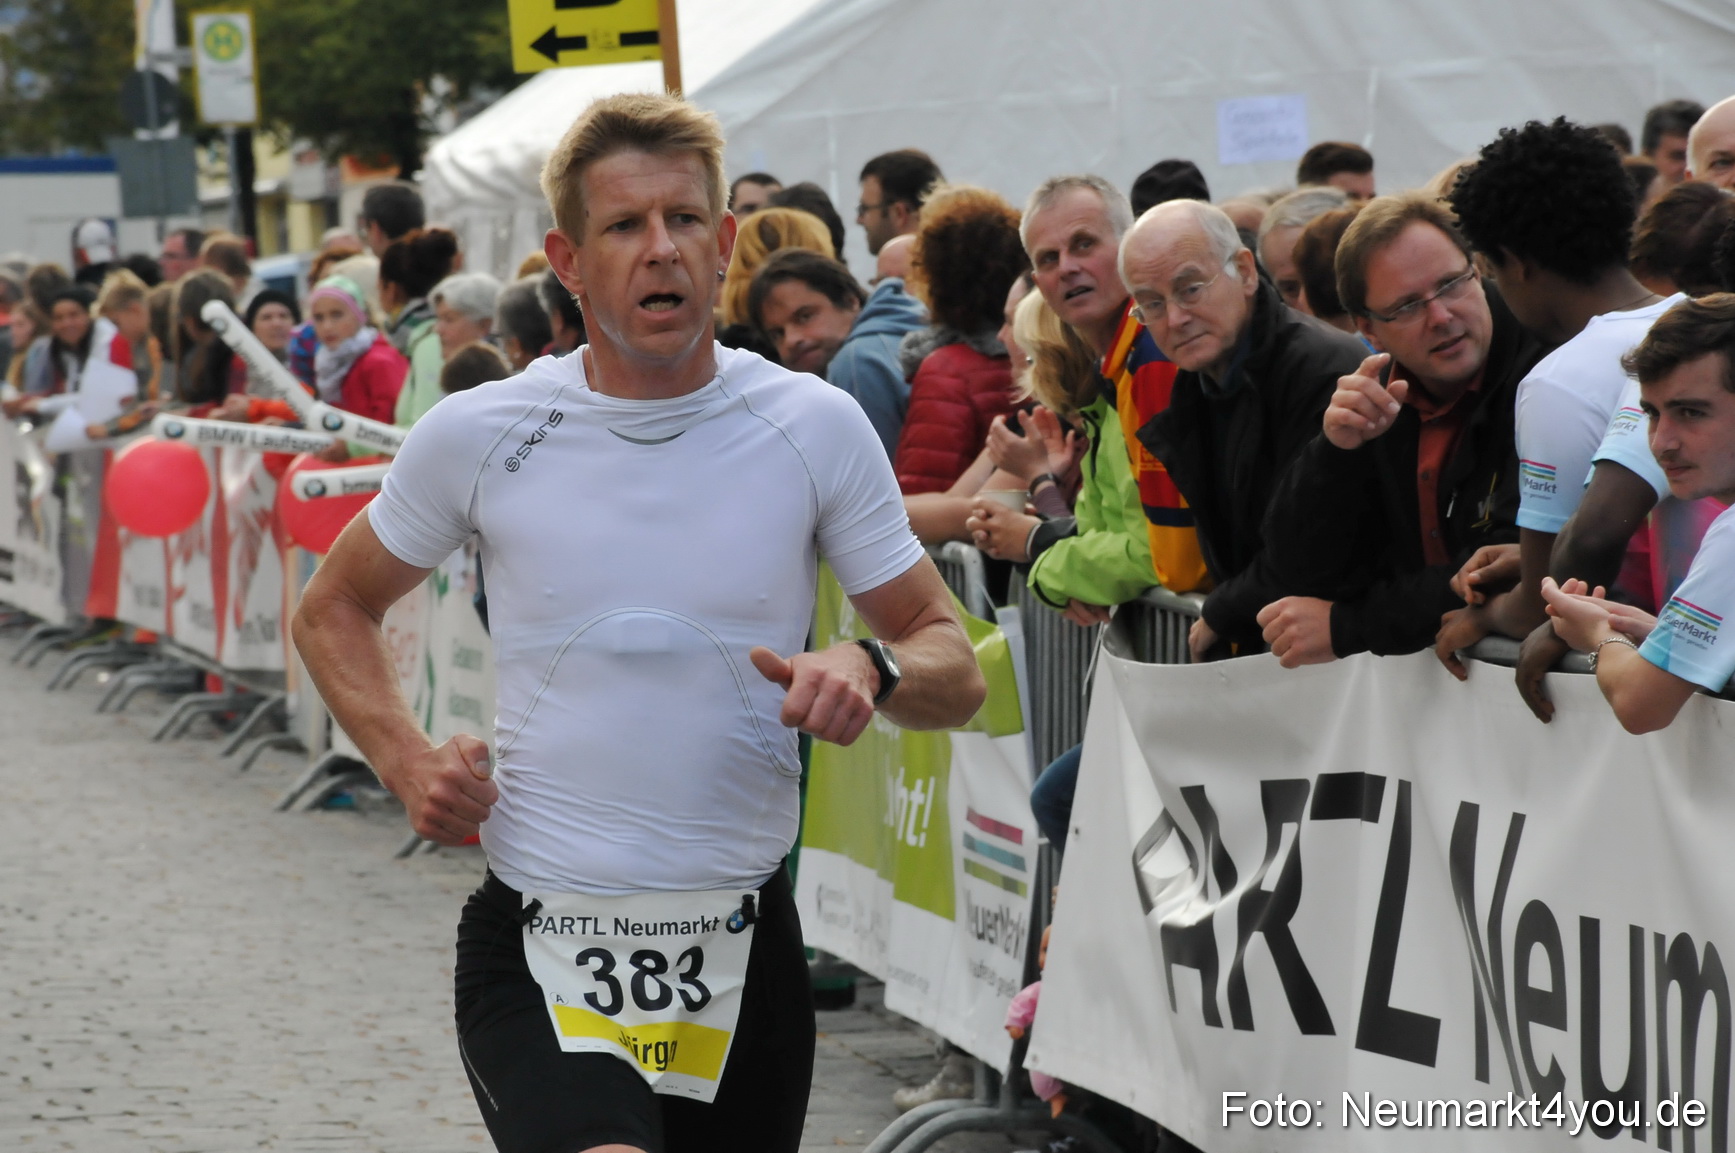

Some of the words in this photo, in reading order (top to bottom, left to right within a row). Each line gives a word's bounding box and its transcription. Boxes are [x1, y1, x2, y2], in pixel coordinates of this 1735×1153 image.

[529, 916, 606, 935] PARTL
[614, 915, 720, 936] Neumarkt
[575, 946, 712, 1017] 383
